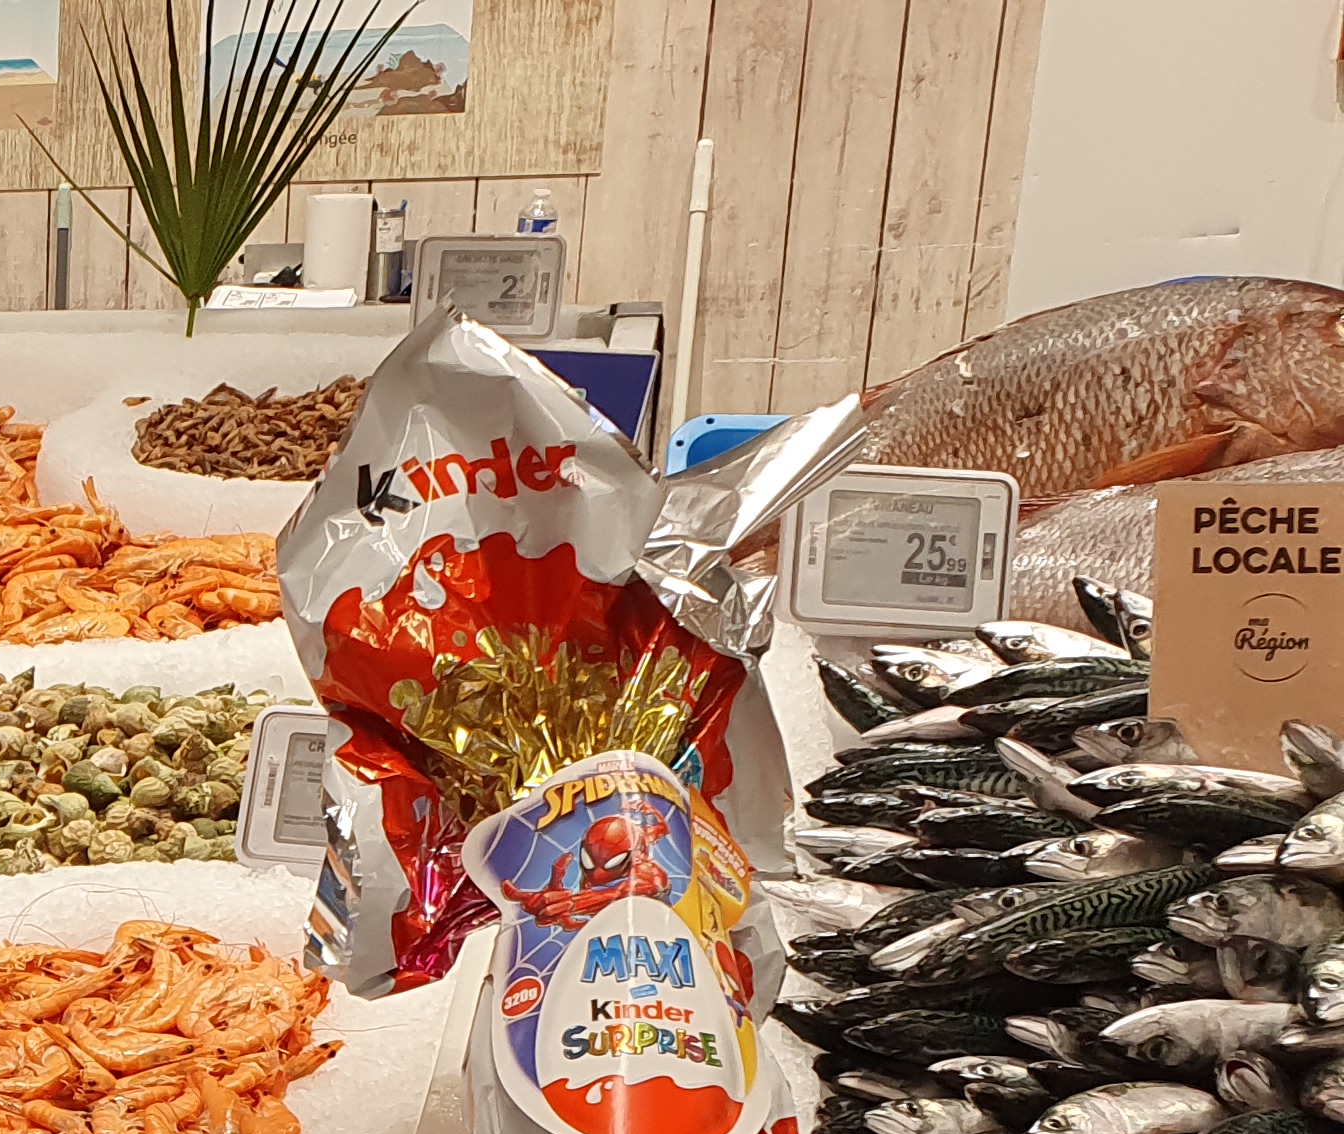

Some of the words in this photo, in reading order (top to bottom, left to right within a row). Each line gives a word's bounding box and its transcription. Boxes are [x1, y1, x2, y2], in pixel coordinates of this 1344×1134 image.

[357, 437, 584, 527] Kinder
[1193, 497, 1320, 534] PÊCHE
[904, 532, 947, 571] 25
[946, 557, 967, 573] 99
[1192, 546, 1342, 574] LOCALE
[1234, 627, 1310, 662] Région
[581, 934, 696, 988] MAXI
[503, 986, 539, 1010] 320g
[590, 999, 695, 1024] Kinder
[562, 1022, 723, 1068] SURPRISE
